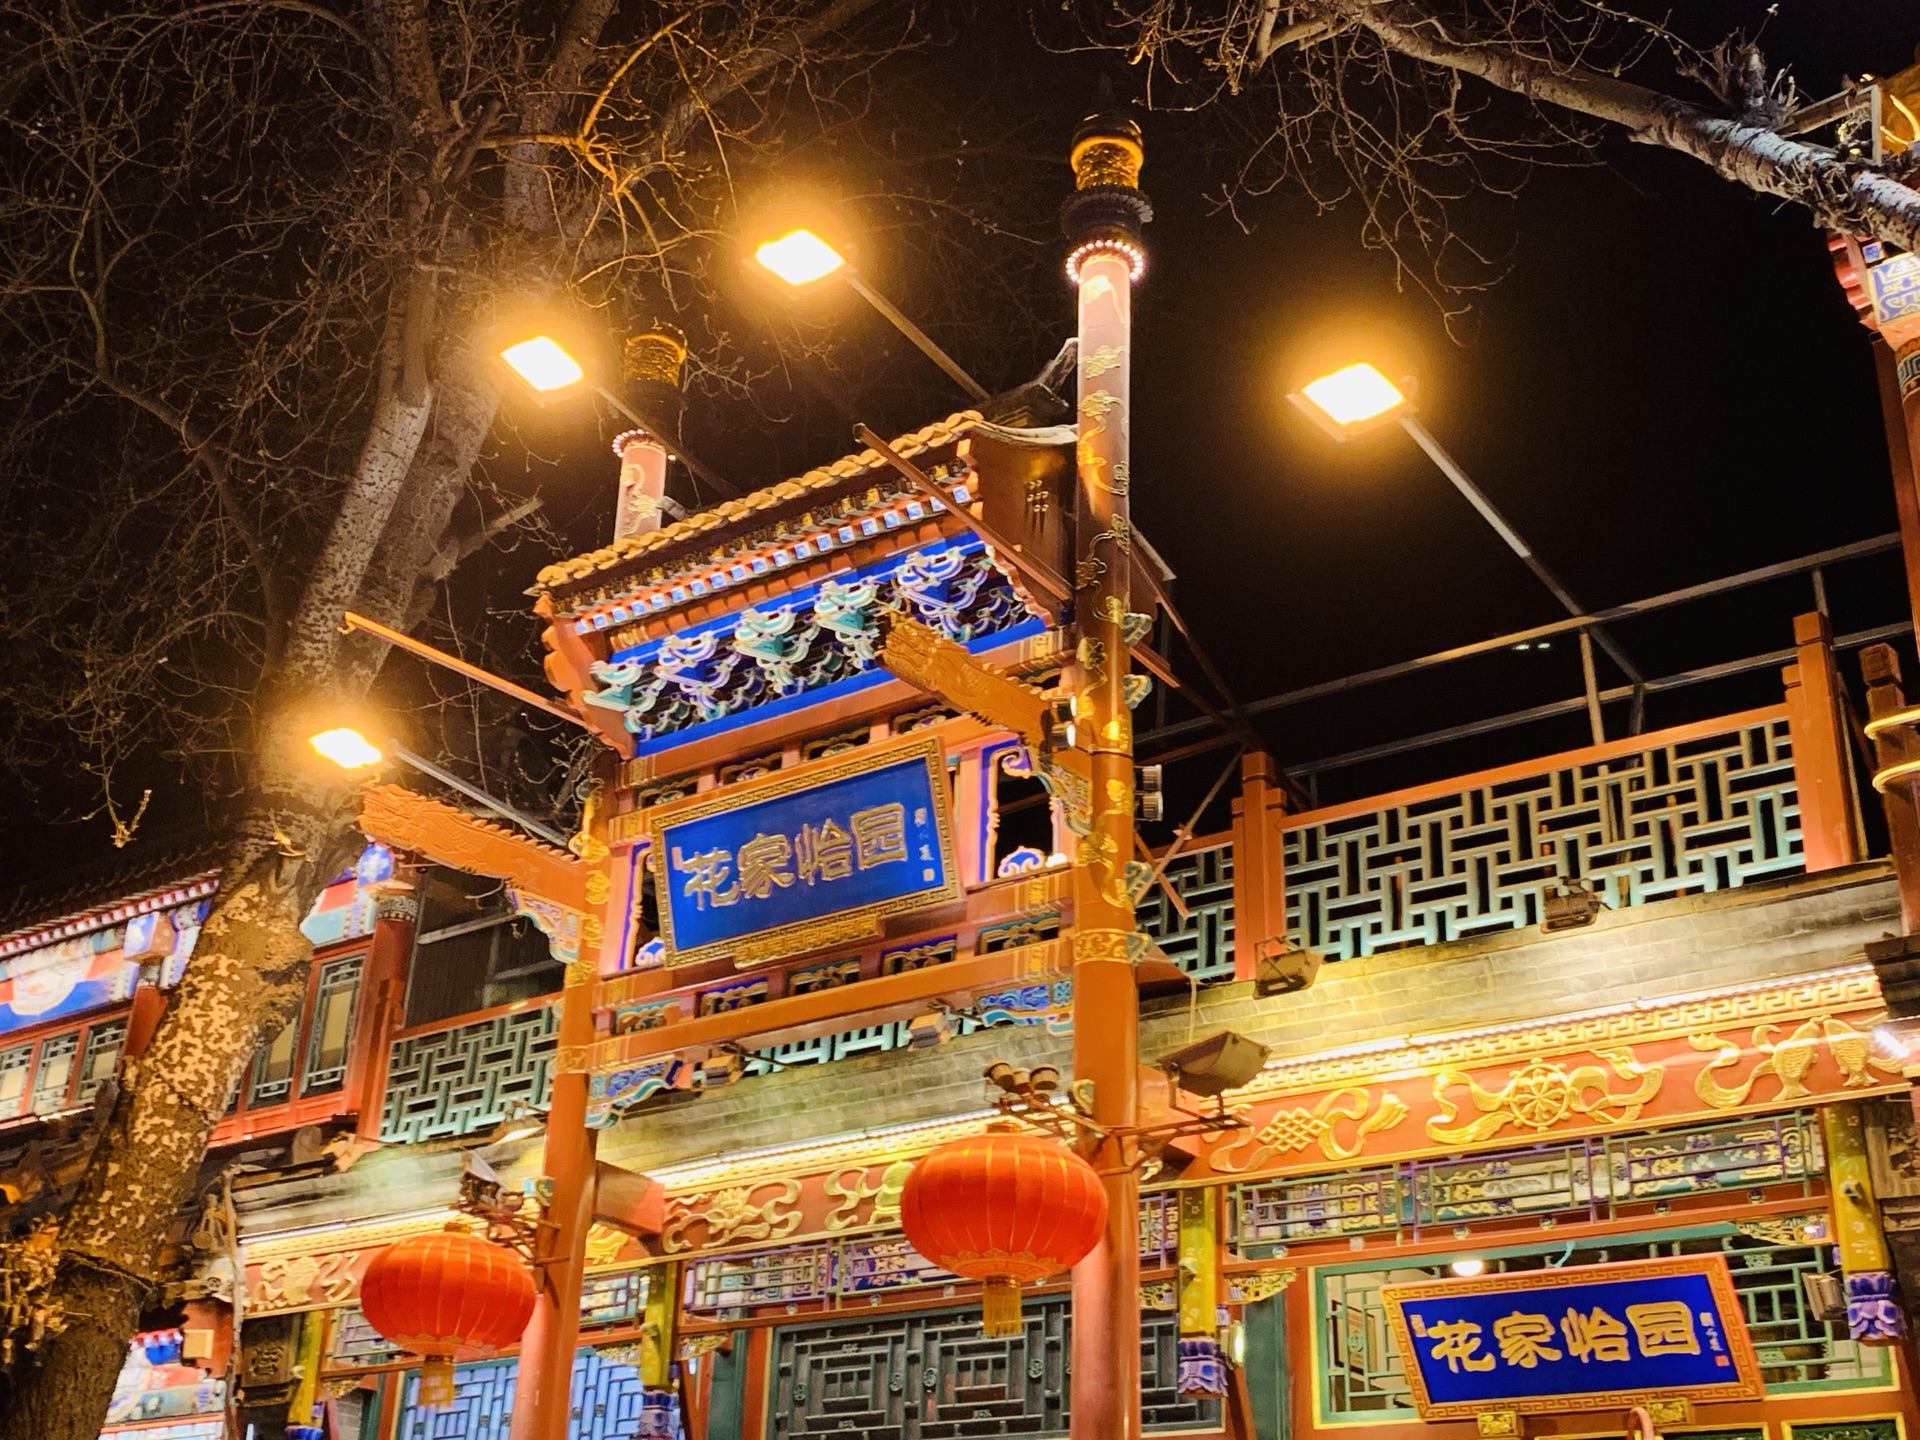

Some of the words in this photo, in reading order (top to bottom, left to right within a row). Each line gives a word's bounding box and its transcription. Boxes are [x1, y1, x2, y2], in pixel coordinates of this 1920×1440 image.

[684, 802, 908, 911] 花家怡园
[1427, 1301, 1700, 1373] 花家怡园
